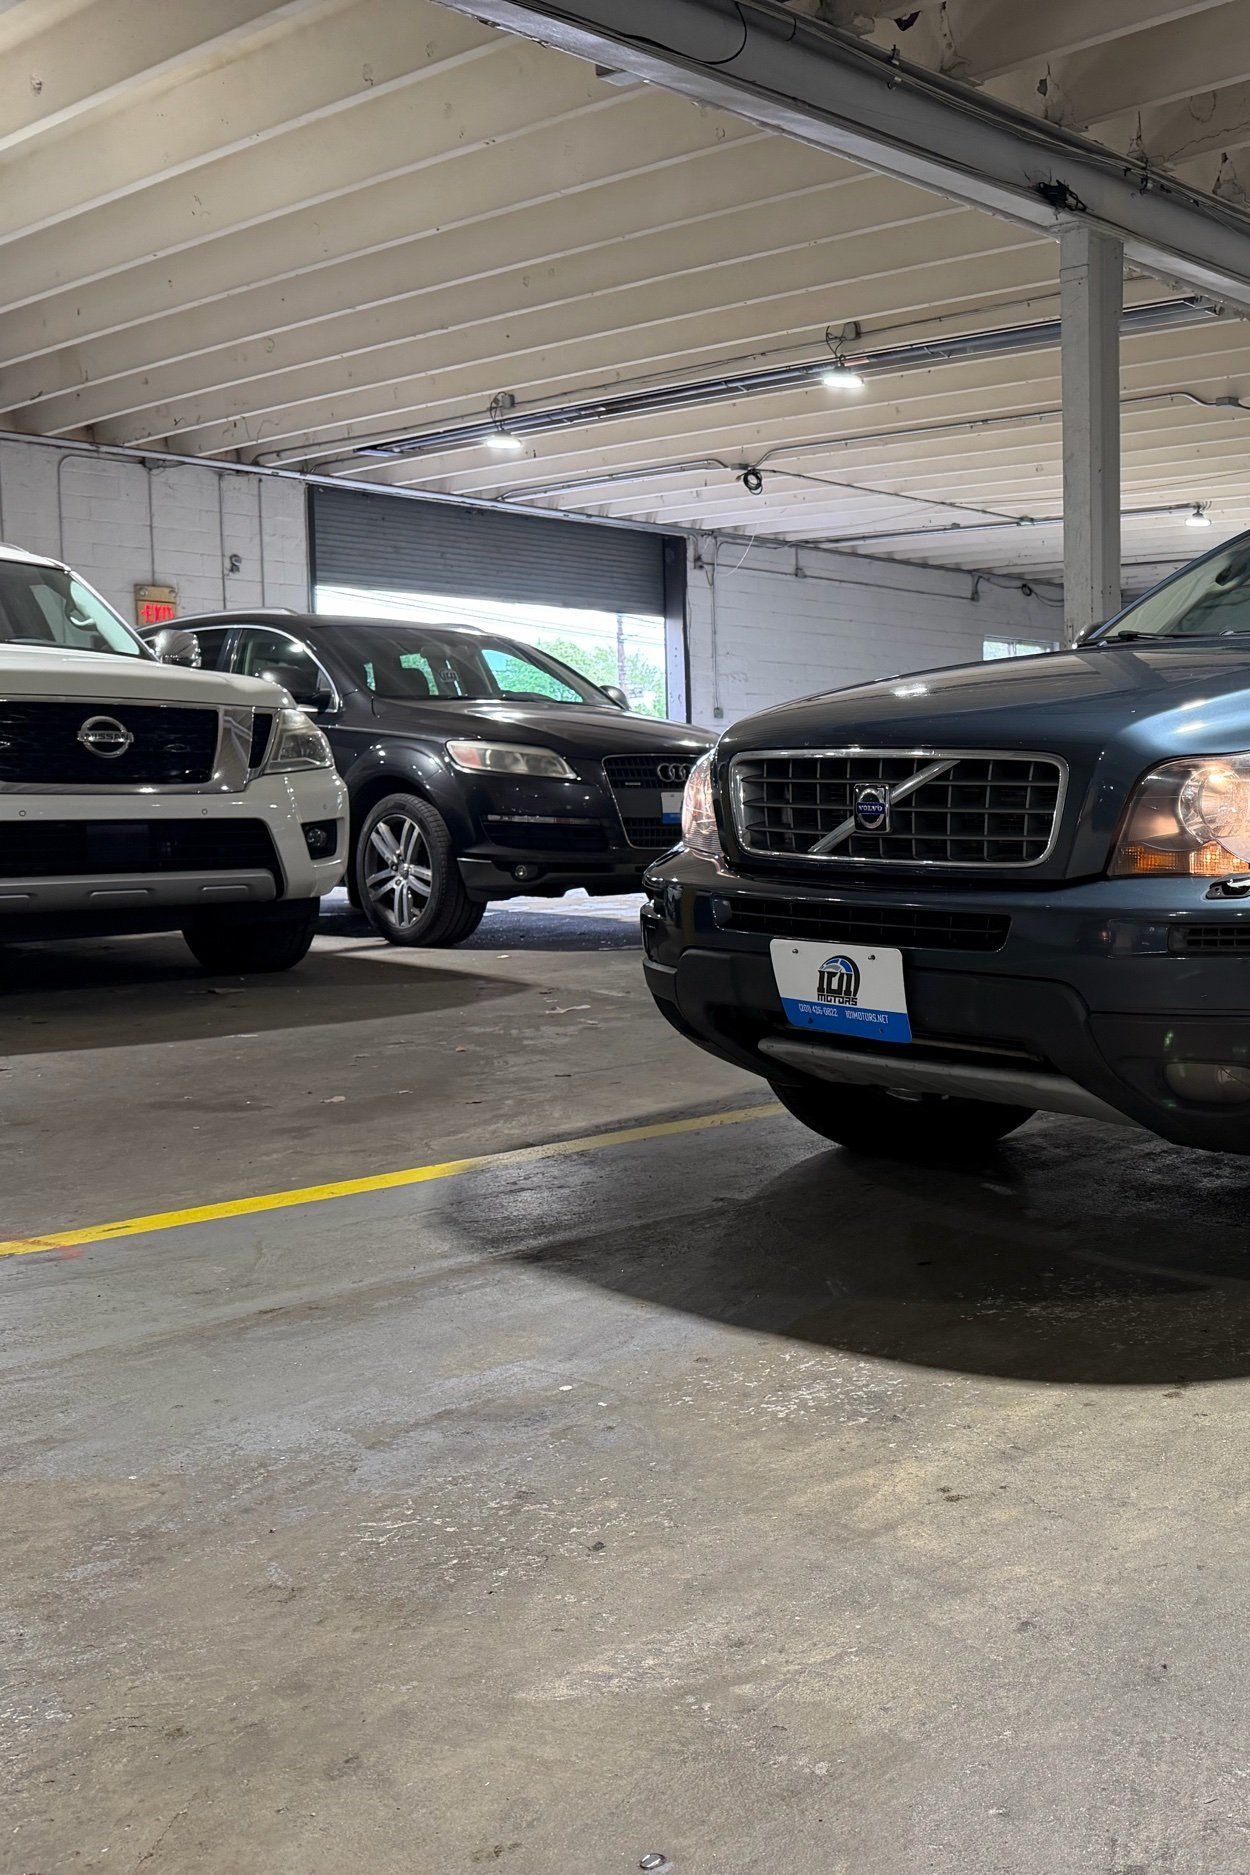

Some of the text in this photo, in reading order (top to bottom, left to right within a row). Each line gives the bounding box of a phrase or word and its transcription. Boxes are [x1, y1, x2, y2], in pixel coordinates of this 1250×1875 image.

[145, 603, 173, 623] EXIT
[85, 732, 129, 741] NISSAN
[858, 804, 883, 812] VOLVO
[817, 969, 854, 996] 101
[817, 993, 858, 1006] MOTORS
